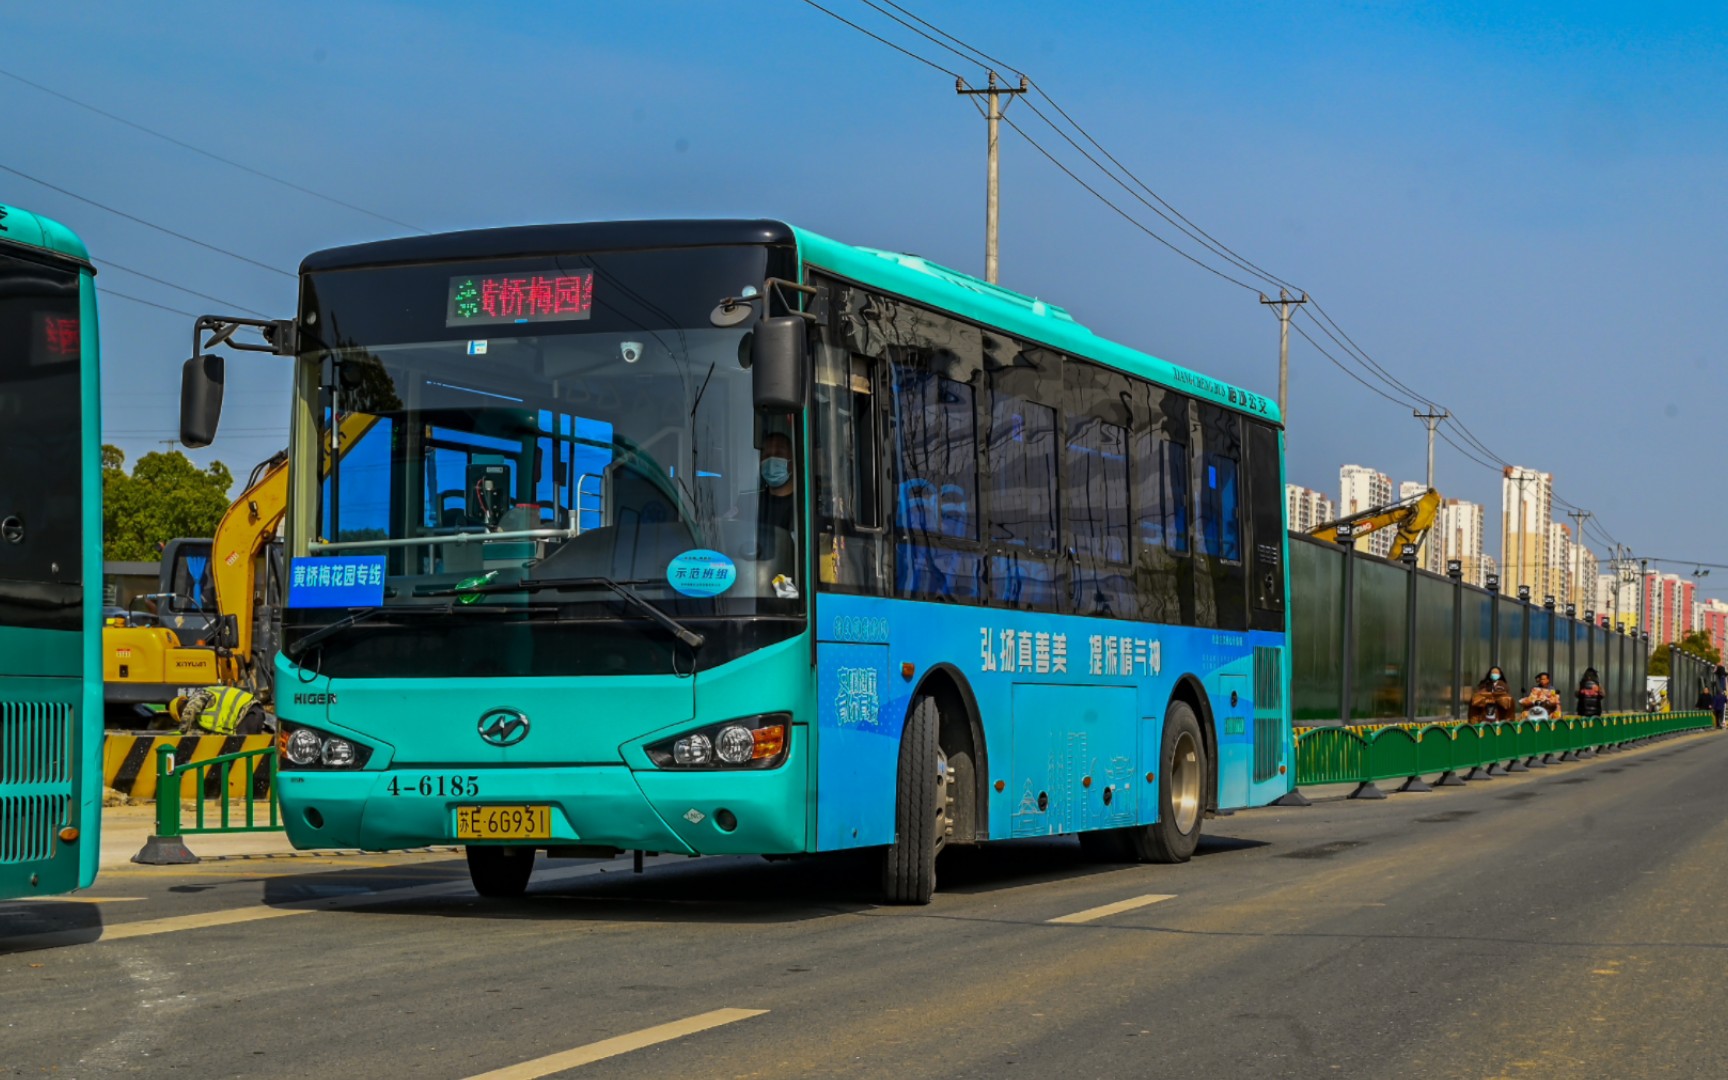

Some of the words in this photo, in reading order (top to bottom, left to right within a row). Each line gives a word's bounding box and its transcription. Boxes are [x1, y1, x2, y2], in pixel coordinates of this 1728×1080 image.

[293, 564, 382, 588] 黄桥梅花园专线
[675, 567, 728, 580] 示范班组
[980, 627, 1067, 674] 弘扬真善美
[1089, 634, 1161, 677] 提振精气神
[294, 693, 338, 705] HIGER
[387, 775, 479, 797] 4-6185
